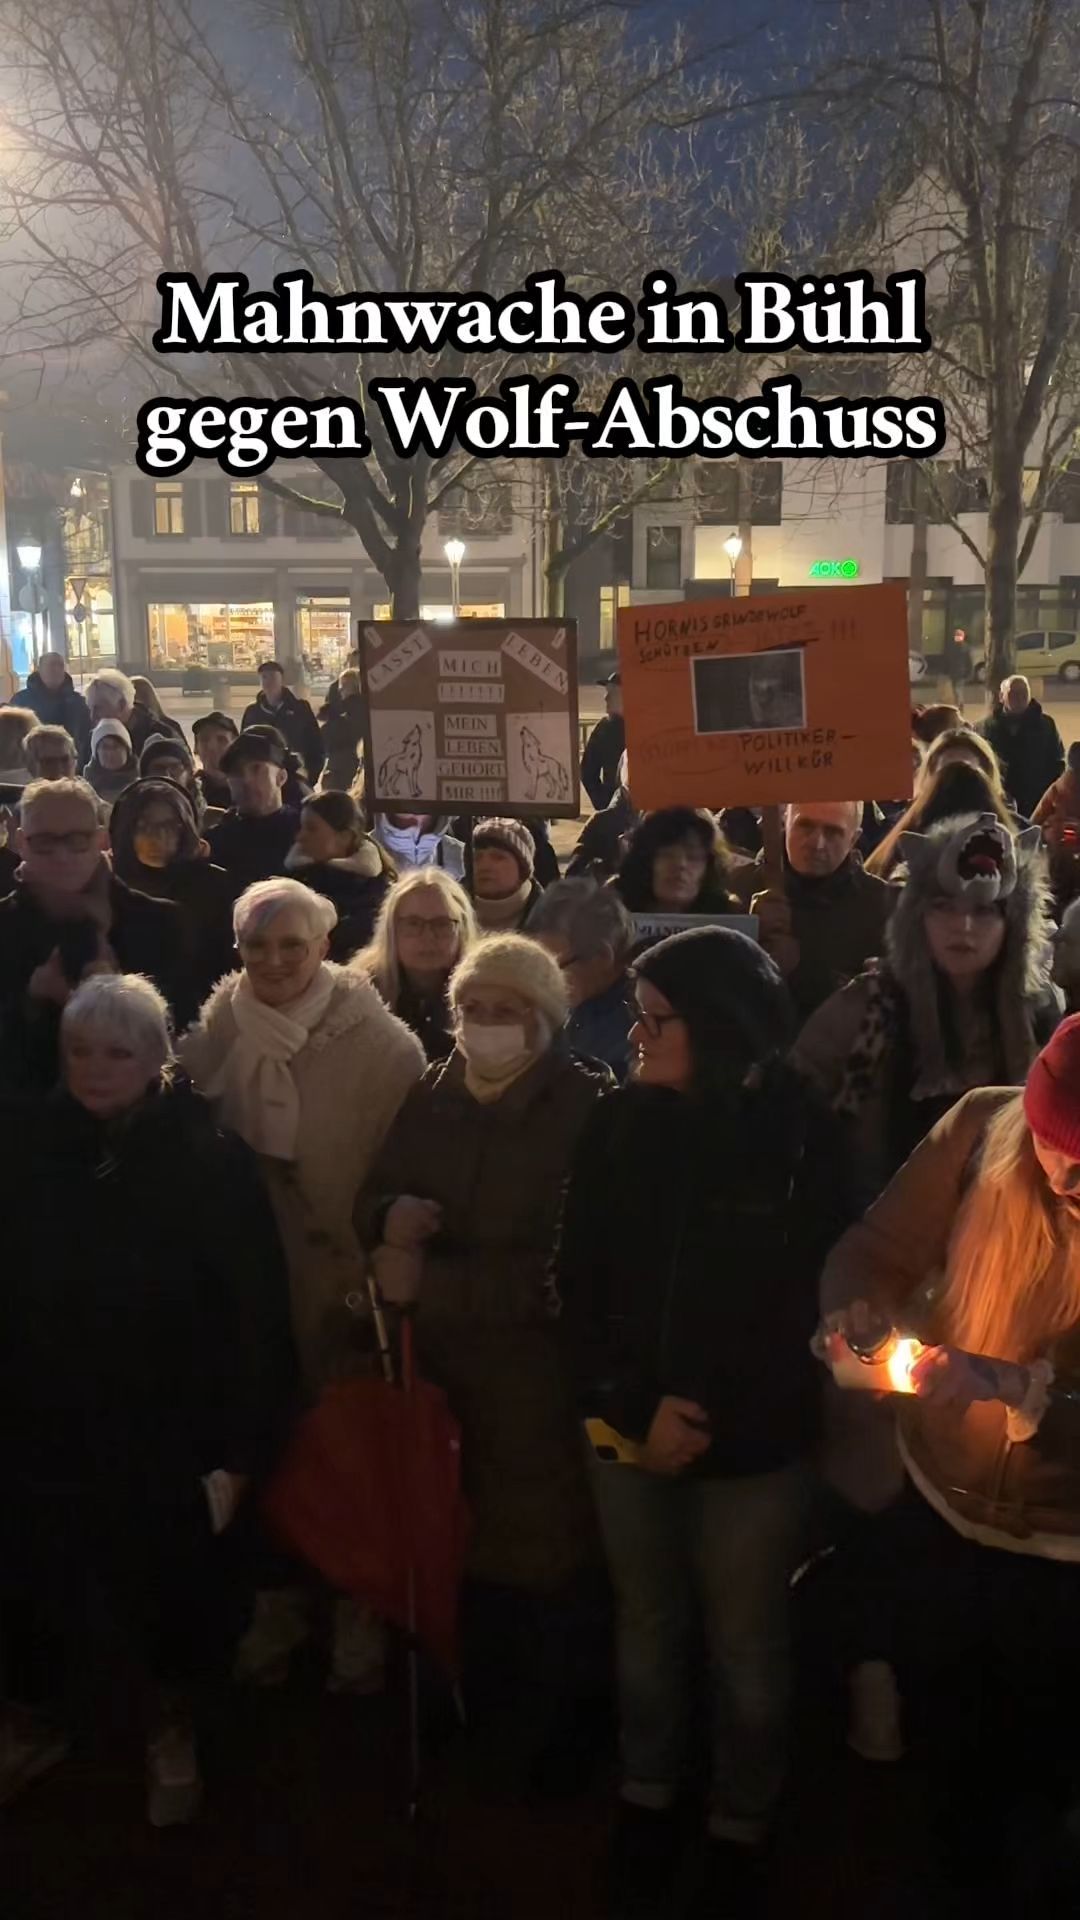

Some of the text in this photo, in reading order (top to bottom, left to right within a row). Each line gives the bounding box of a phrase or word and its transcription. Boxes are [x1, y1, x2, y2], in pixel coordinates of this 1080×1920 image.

[808, 560, 841, 577] AOK
[442, 657, 499, 674] MICH
[447, 717, 487, 730] MEIN
[447, 741, 499, 753] LEBEN
[446, 786, 475, 800] MIR
